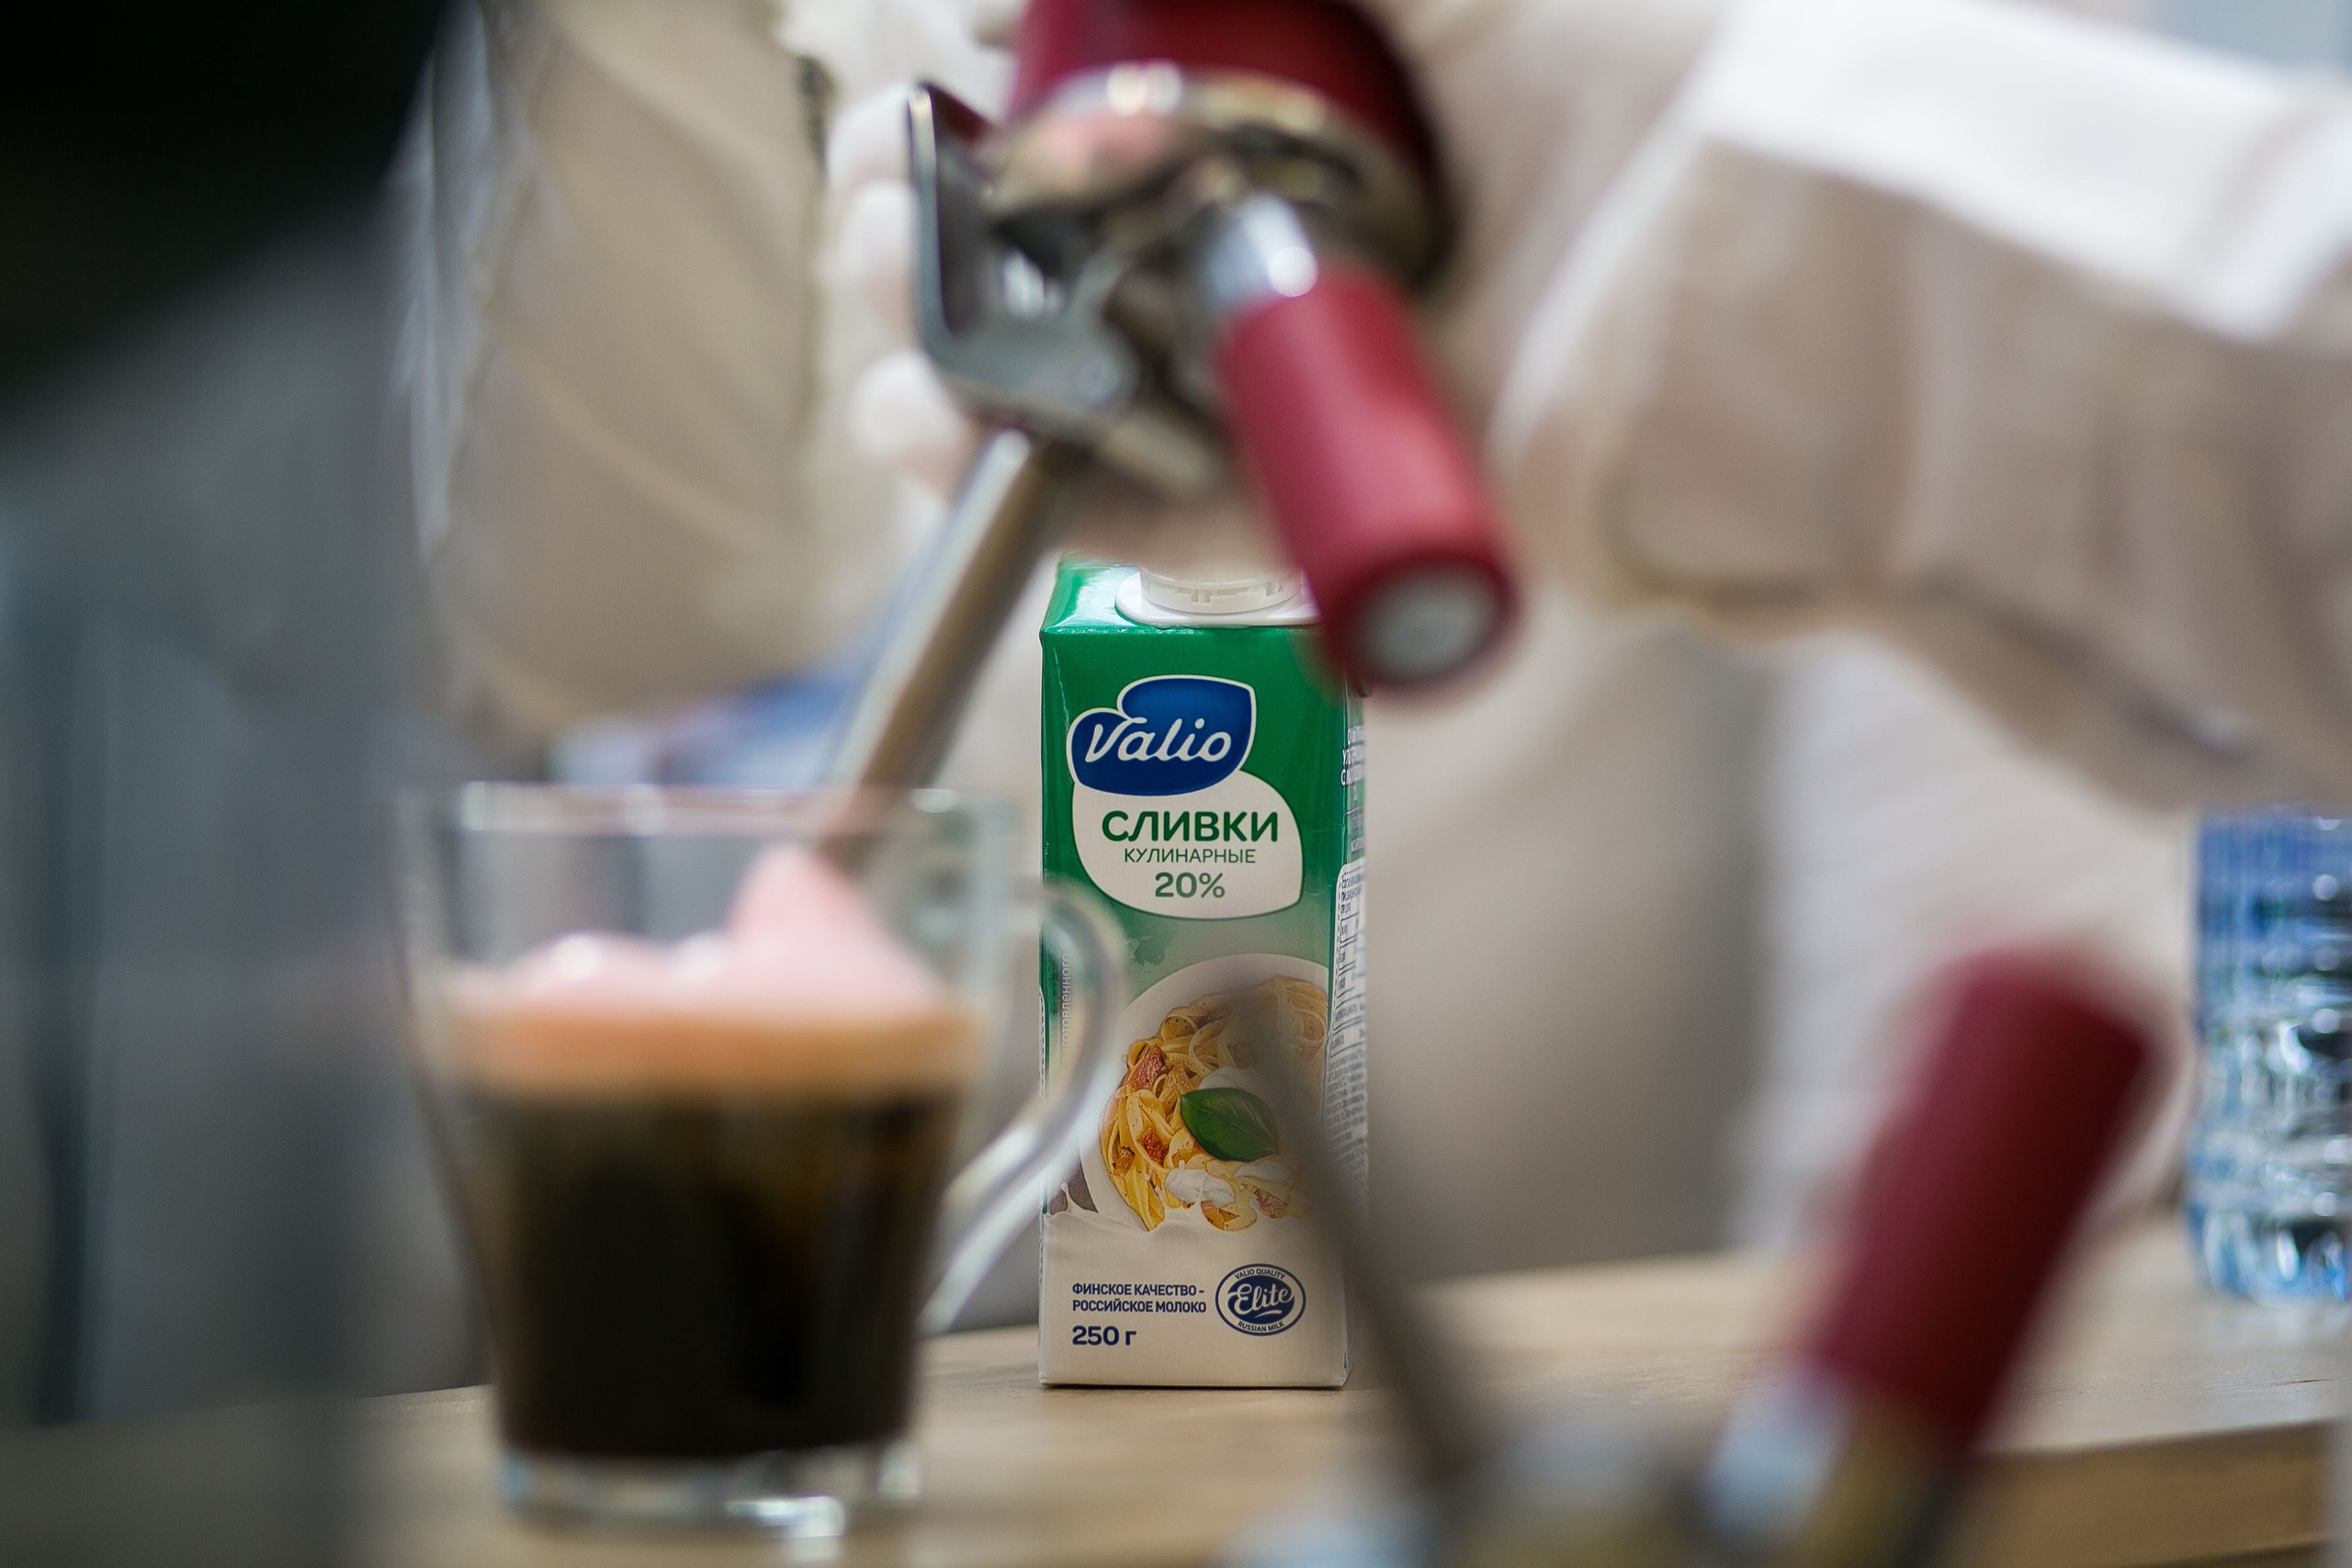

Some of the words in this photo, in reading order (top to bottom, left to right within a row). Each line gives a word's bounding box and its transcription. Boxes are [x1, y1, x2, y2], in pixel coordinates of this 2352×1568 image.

[1085, 716, 1232, 763] Valio
[1102, 810, 1278, 841] СЛИВКИ
[1124, 848, 1257, 864] КУЛИНАРНЫЕ
[1155, 872, 1226, 898] 20%
[1234, 1269, 1255, 1280] VALIO
[1256, 1268, 1286, 1280] QUALITY
[1071, 1282, 1132, 1296] ФИНСКОЕ
[1134, 1283, 1197, 1297] КАЧЕСТВО
[1227, 1283, 1295, 1315] Elite
[1071, 1298, 1154, 1313] РОССИЙСКОЕ
[1156, 1300, 1207, 1314] МОЛОКО
[1072, 1325, 1120, 1347] 250
[1125, 1330, 1137, 1347] г
[1238, 1321, 1267, 1333] RUSSIAN
[1268, 1321, 1285, 1332] MILK
